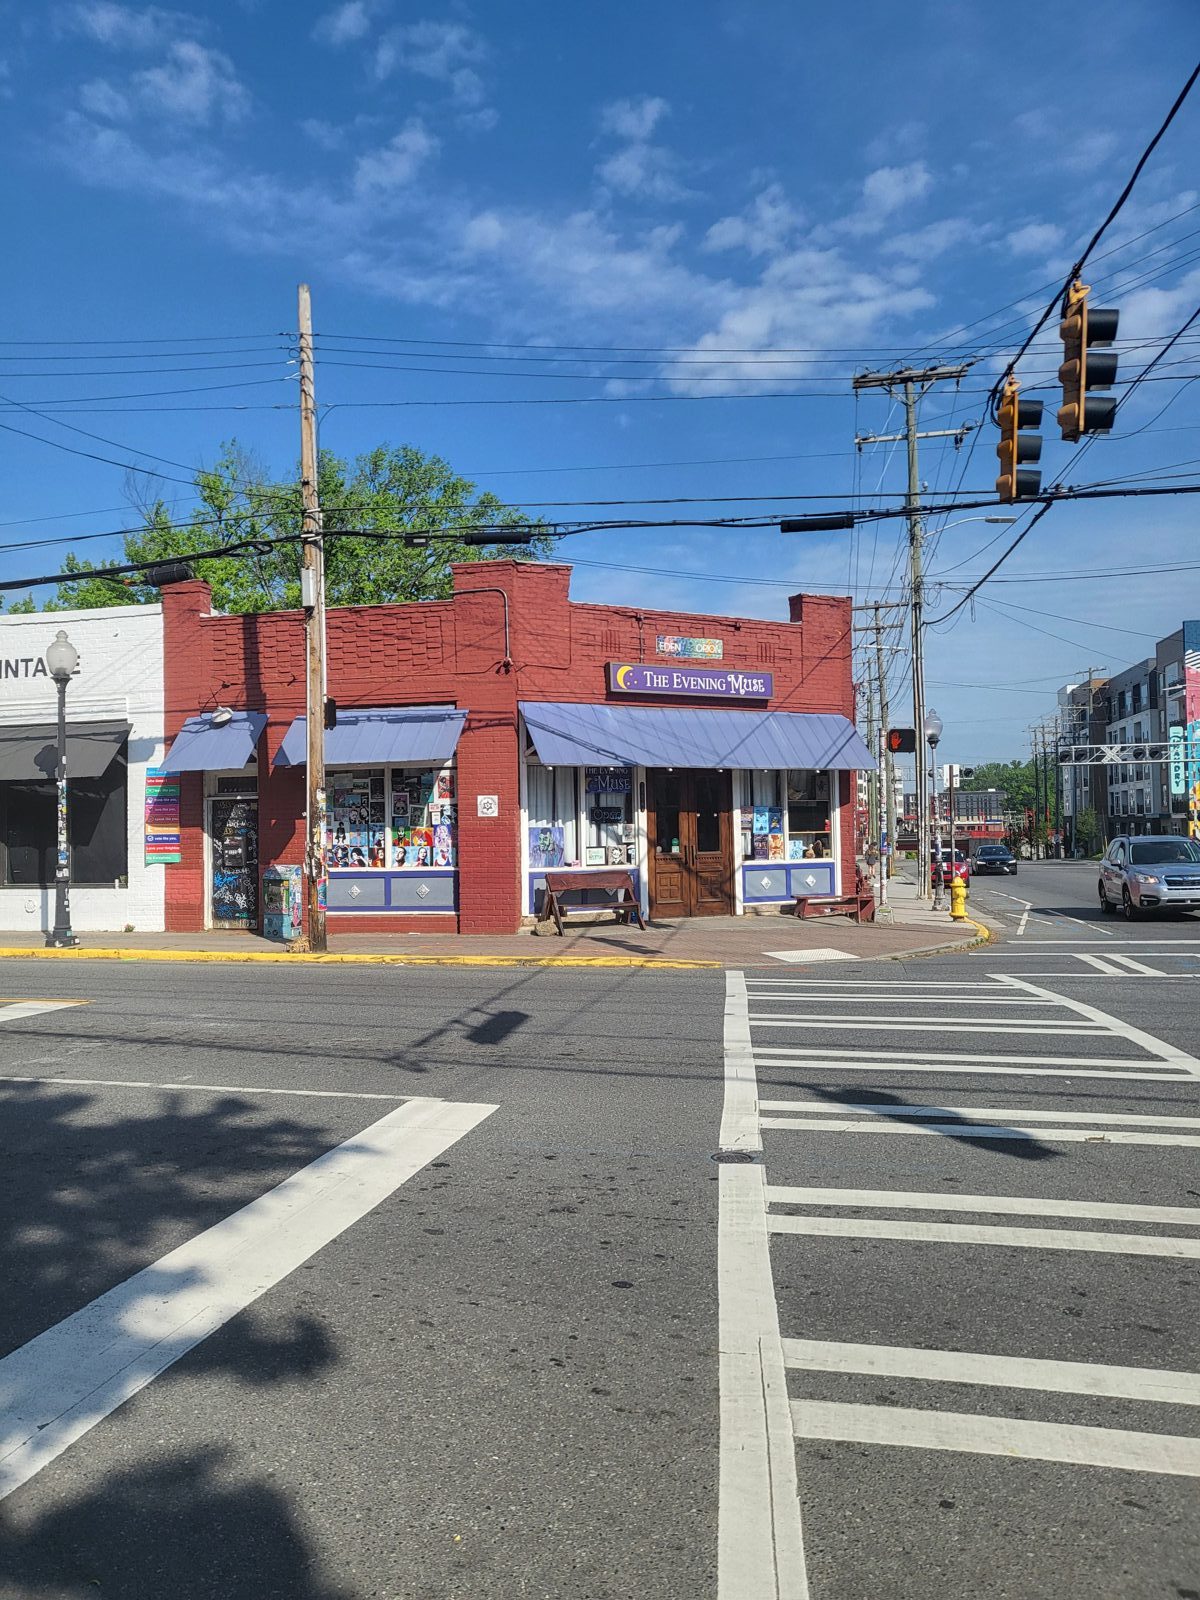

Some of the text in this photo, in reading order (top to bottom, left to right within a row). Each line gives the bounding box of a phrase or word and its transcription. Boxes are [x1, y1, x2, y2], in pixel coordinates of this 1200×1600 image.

[659, 641, 682, 653] EDEN
[643, 671, 765, 695] THE EVENING MUSE
[594, 775, 632, 793] MUSE
